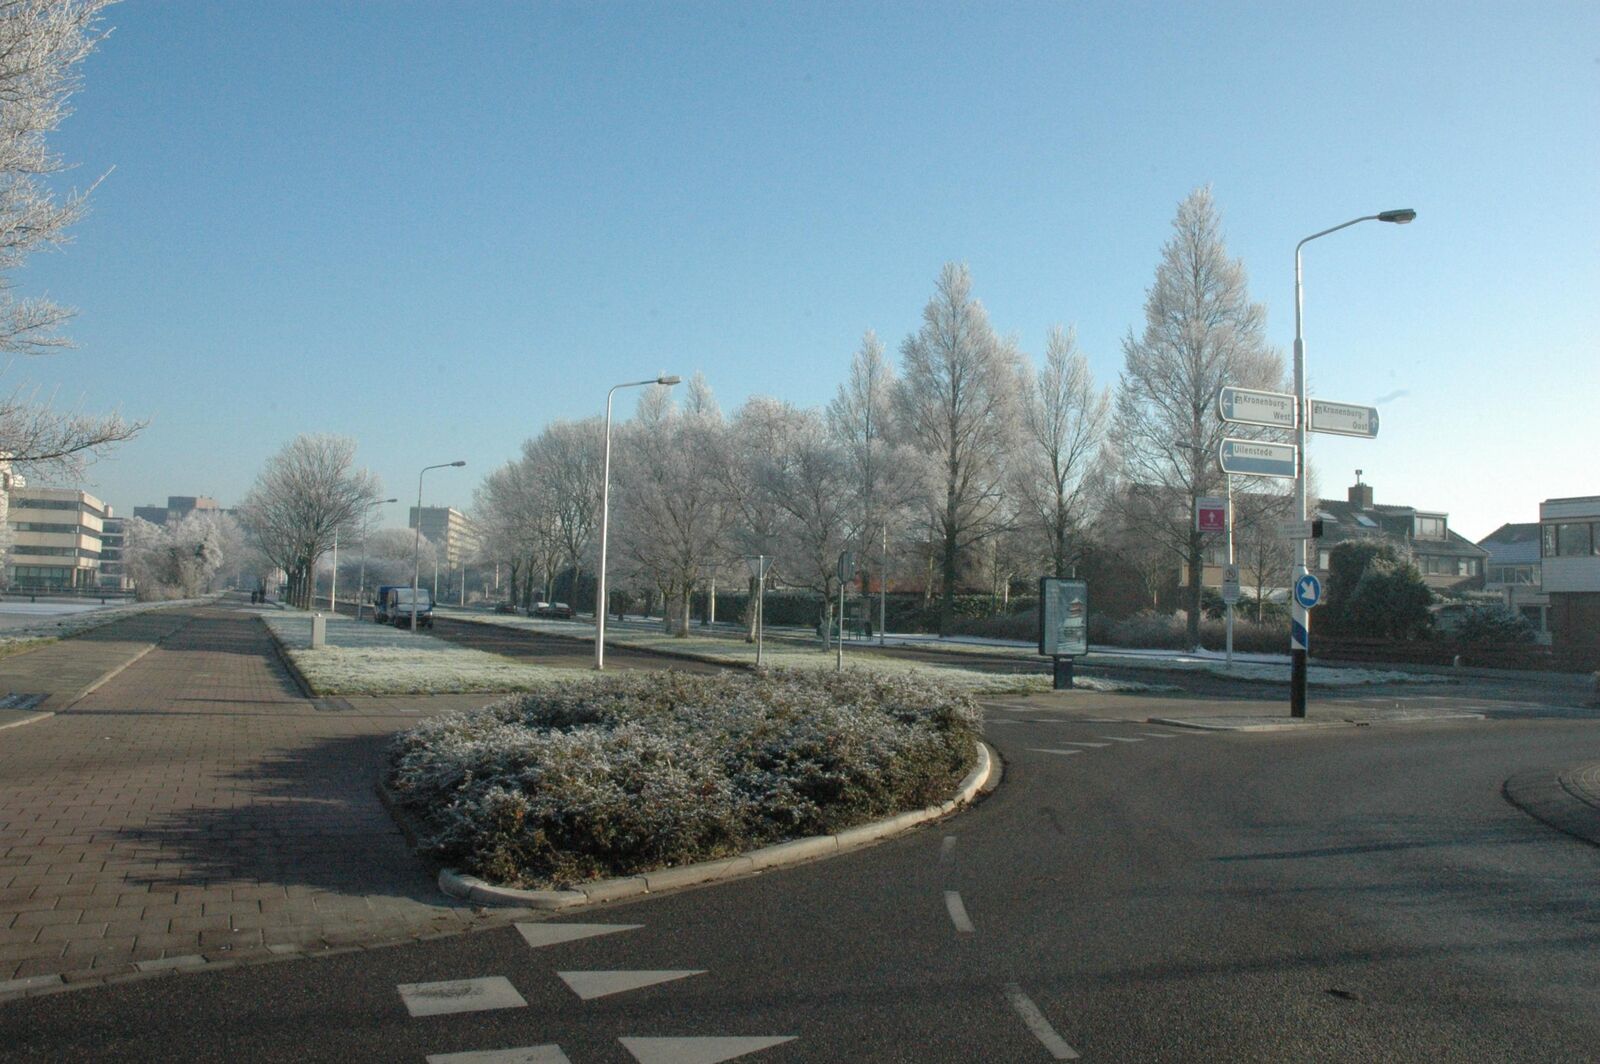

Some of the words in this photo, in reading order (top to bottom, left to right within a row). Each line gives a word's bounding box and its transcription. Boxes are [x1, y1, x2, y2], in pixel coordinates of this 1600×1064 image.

[1273, 411, 1291, 421] West
[1352, 421, 1368, 431] Oost
[1234, 445, 1273, 456] Uilenstede
